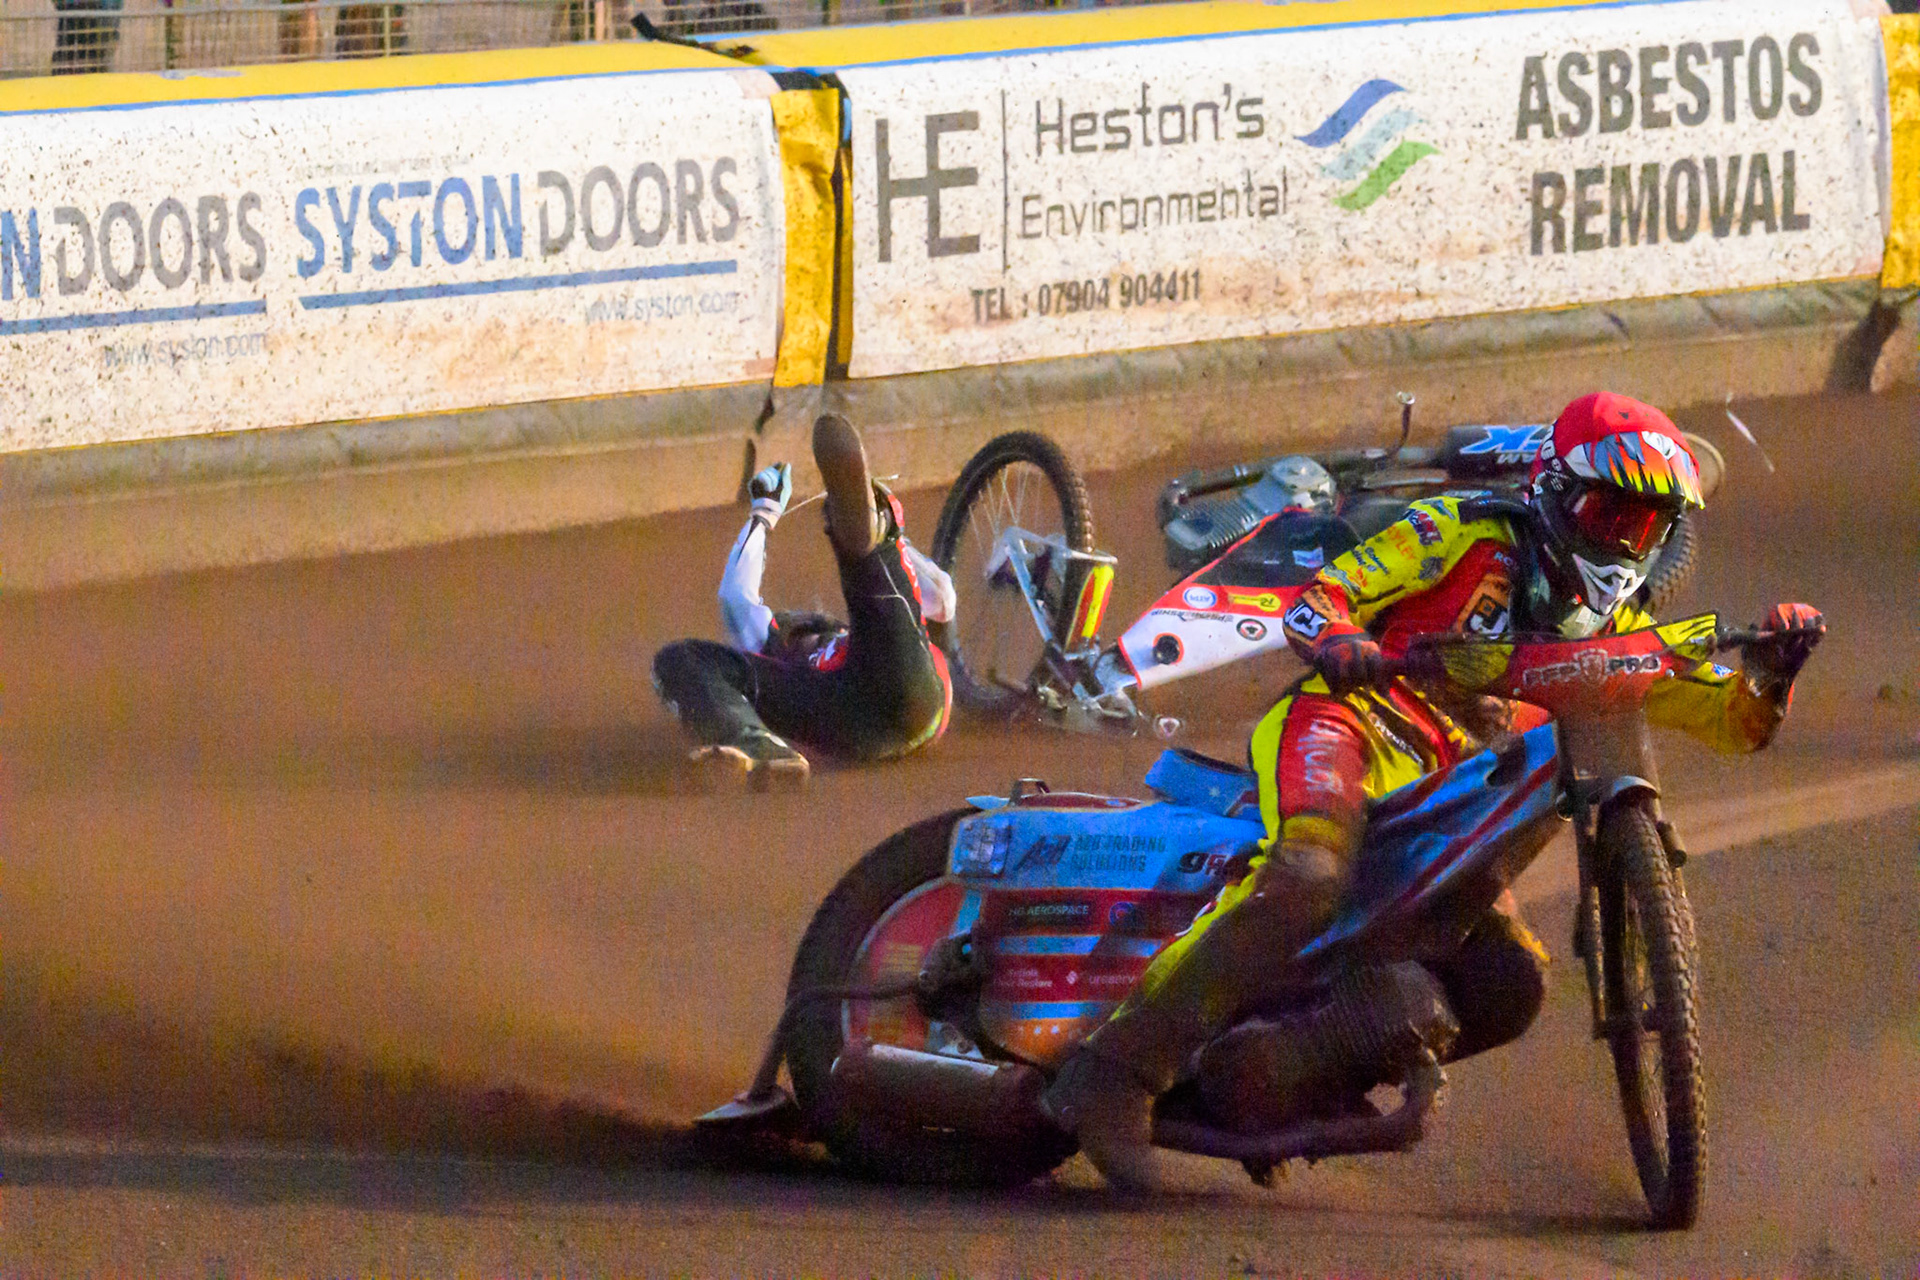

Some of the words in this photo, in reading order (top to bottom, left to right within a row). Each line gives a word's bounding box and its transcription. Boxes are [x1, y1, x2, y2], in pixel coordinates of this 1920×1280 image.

[1036, 82, 1265, 156] Heston's
[1515, 32, 1823, 141] ASBESTOS
[295, 172, 523, 279] SYSTON
[538, 156, 740, 257] DOORS
[876, 110, 980, 263] HE
[1020, 166, 1289, 239] Environmental
[1530, 150, 1811, 257] REMOVAL
[54, 191, 267, 296] DOORS
[1038, 277, 1111, 317] 07904
[1120, 268, 1200, 308] 904411
[1027, 903, 1089, 917] AEROSPACE
